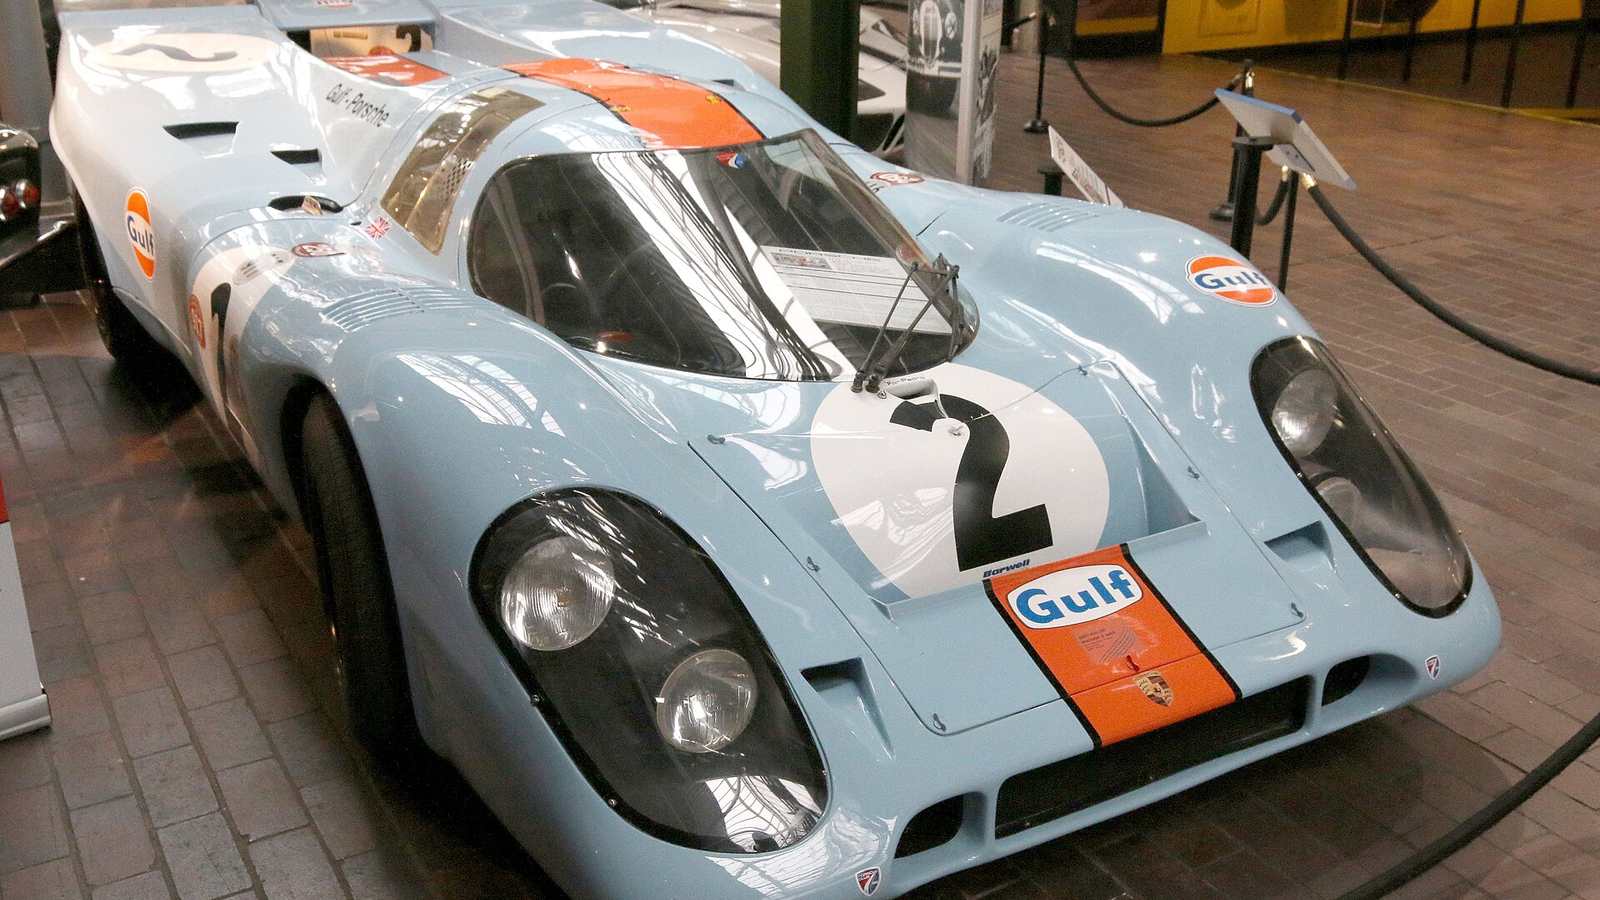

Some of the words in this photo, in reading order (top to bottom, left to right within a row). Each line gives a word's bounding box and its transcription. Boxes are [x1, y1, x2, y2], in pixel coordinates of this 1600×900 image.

[127, 214, 154, 257] Gulf
[1194, 271, 1268, 290] Gulf
[889, 393, 1053, 572] 2
[1015, 569, 1135, 624] Gulf
